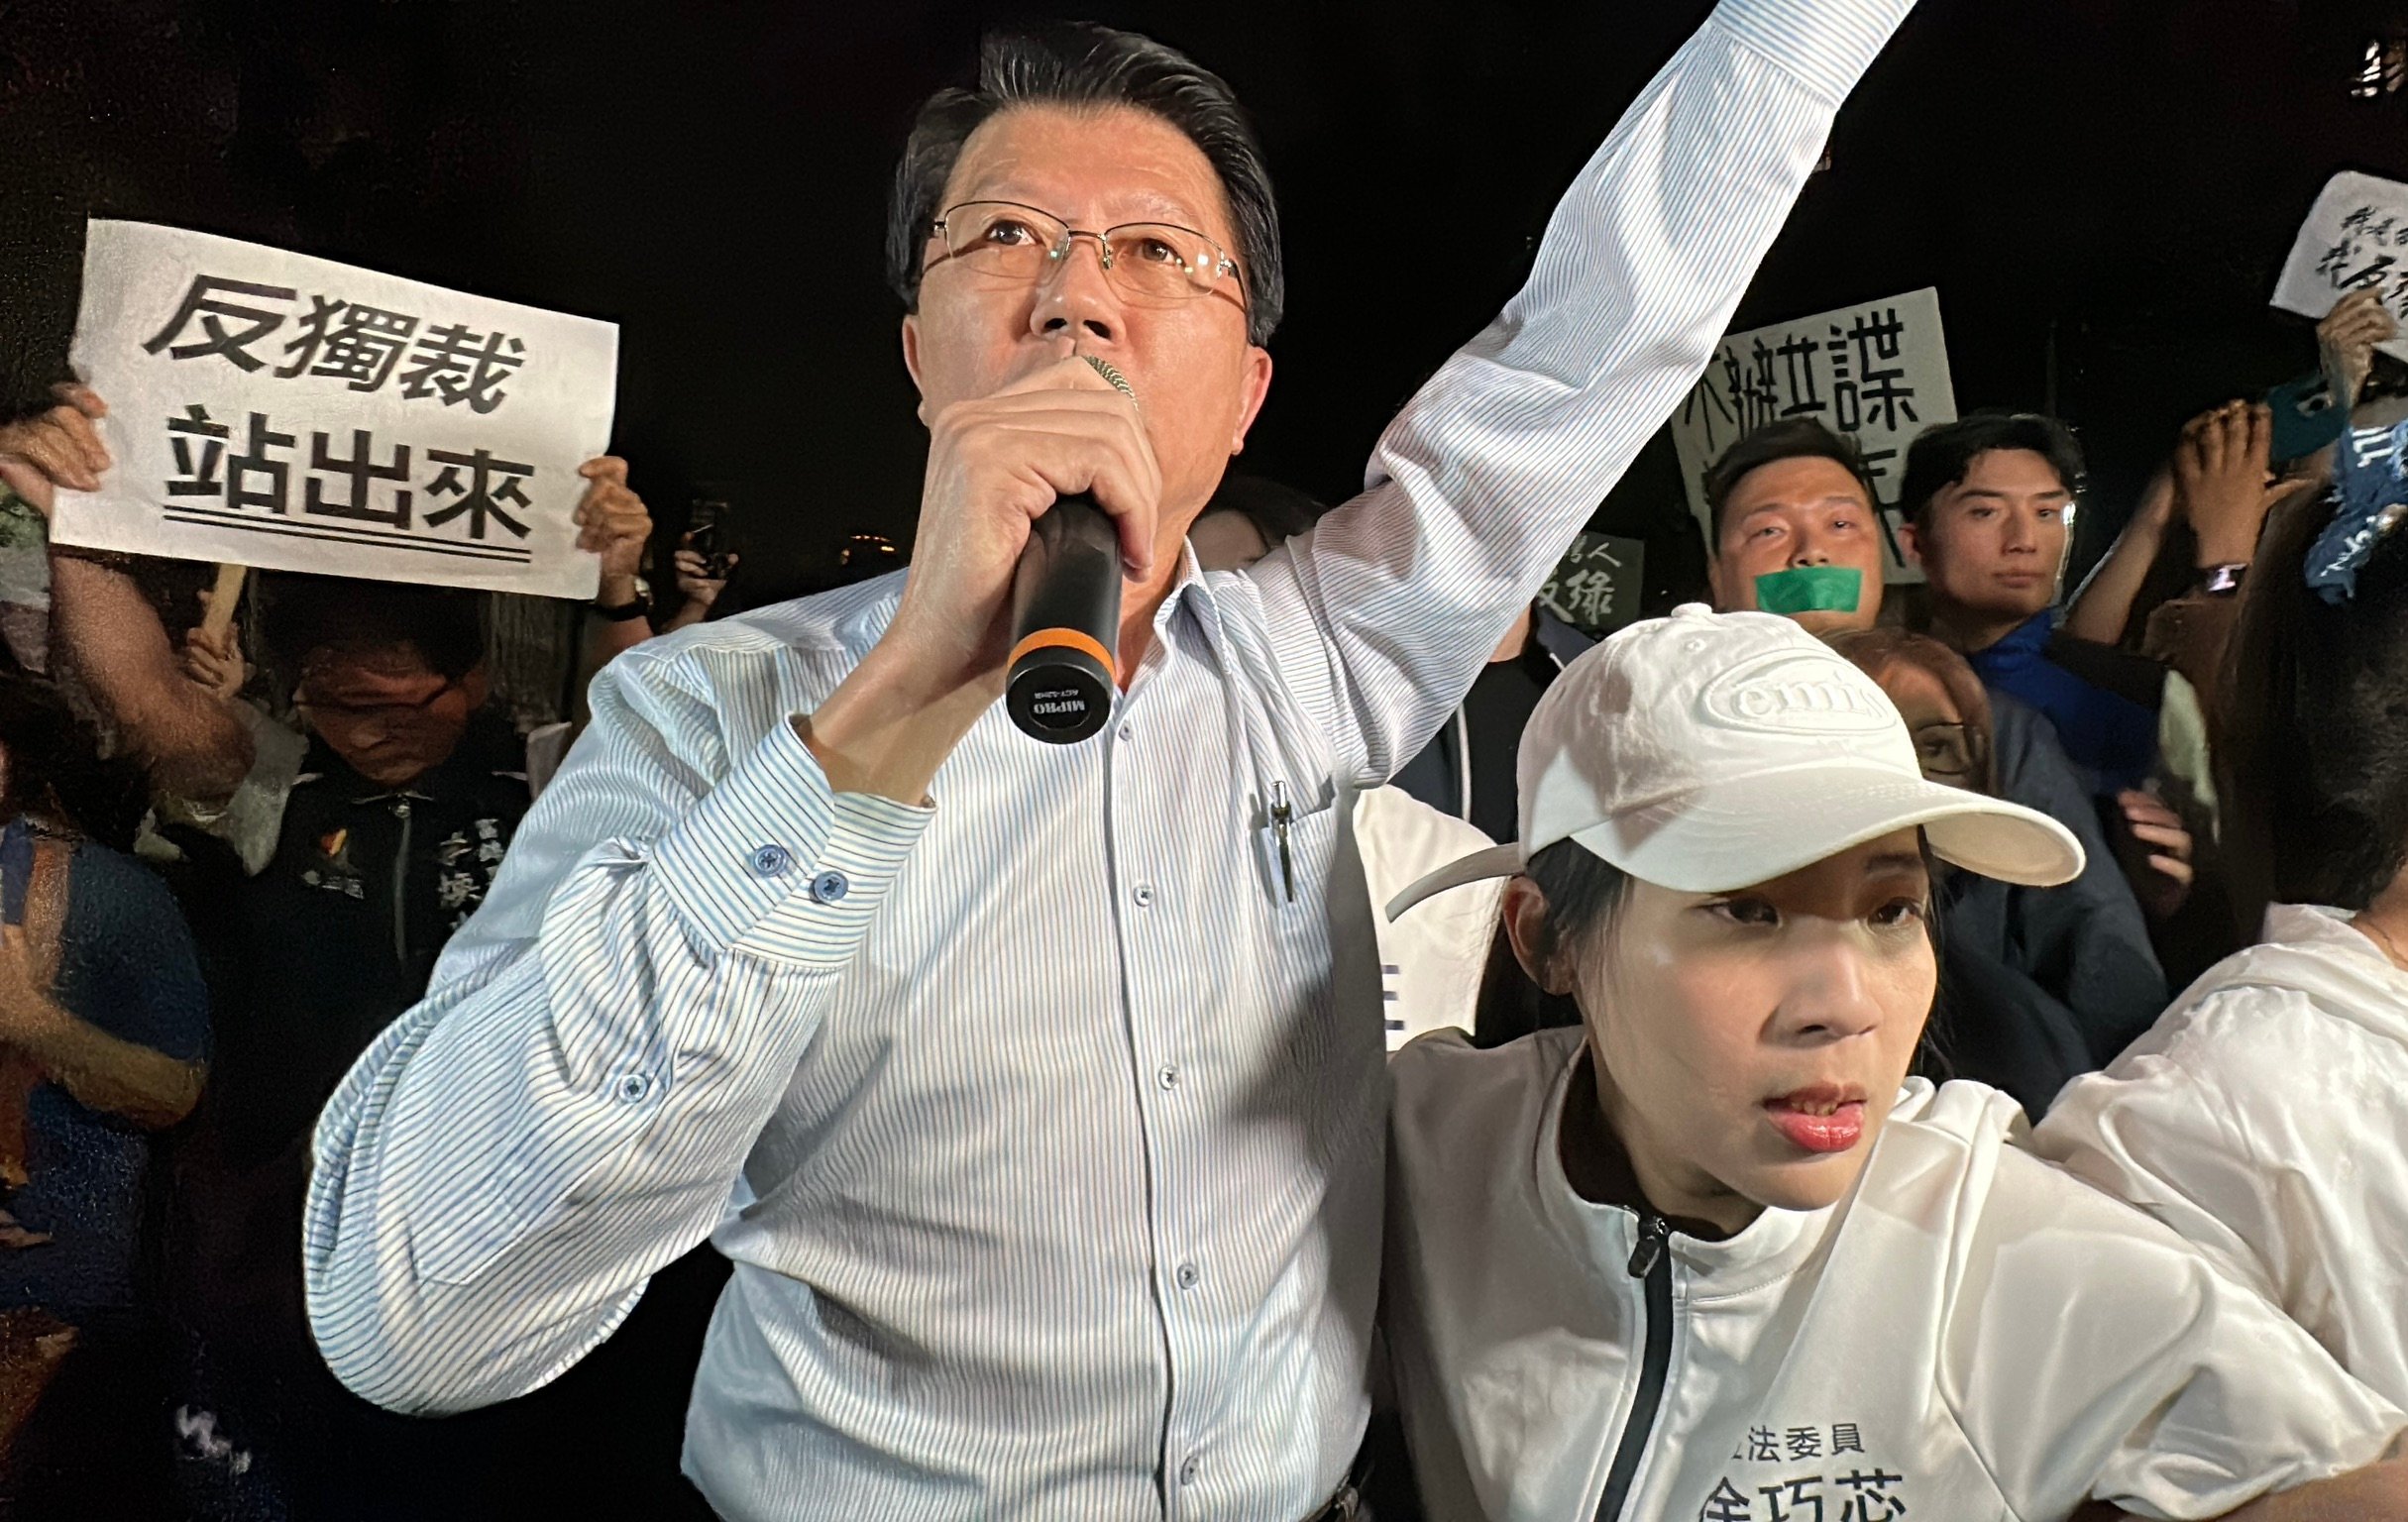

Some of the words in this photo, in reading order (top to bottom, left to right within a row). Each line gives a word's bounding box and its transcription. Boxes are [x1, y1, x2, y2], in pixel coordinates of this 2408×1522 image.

[143, 274, 525, 414] 反獨裁
[166, 403, 535, 539] 站出來
[1034, 700, 1086, 714] MIPRO
